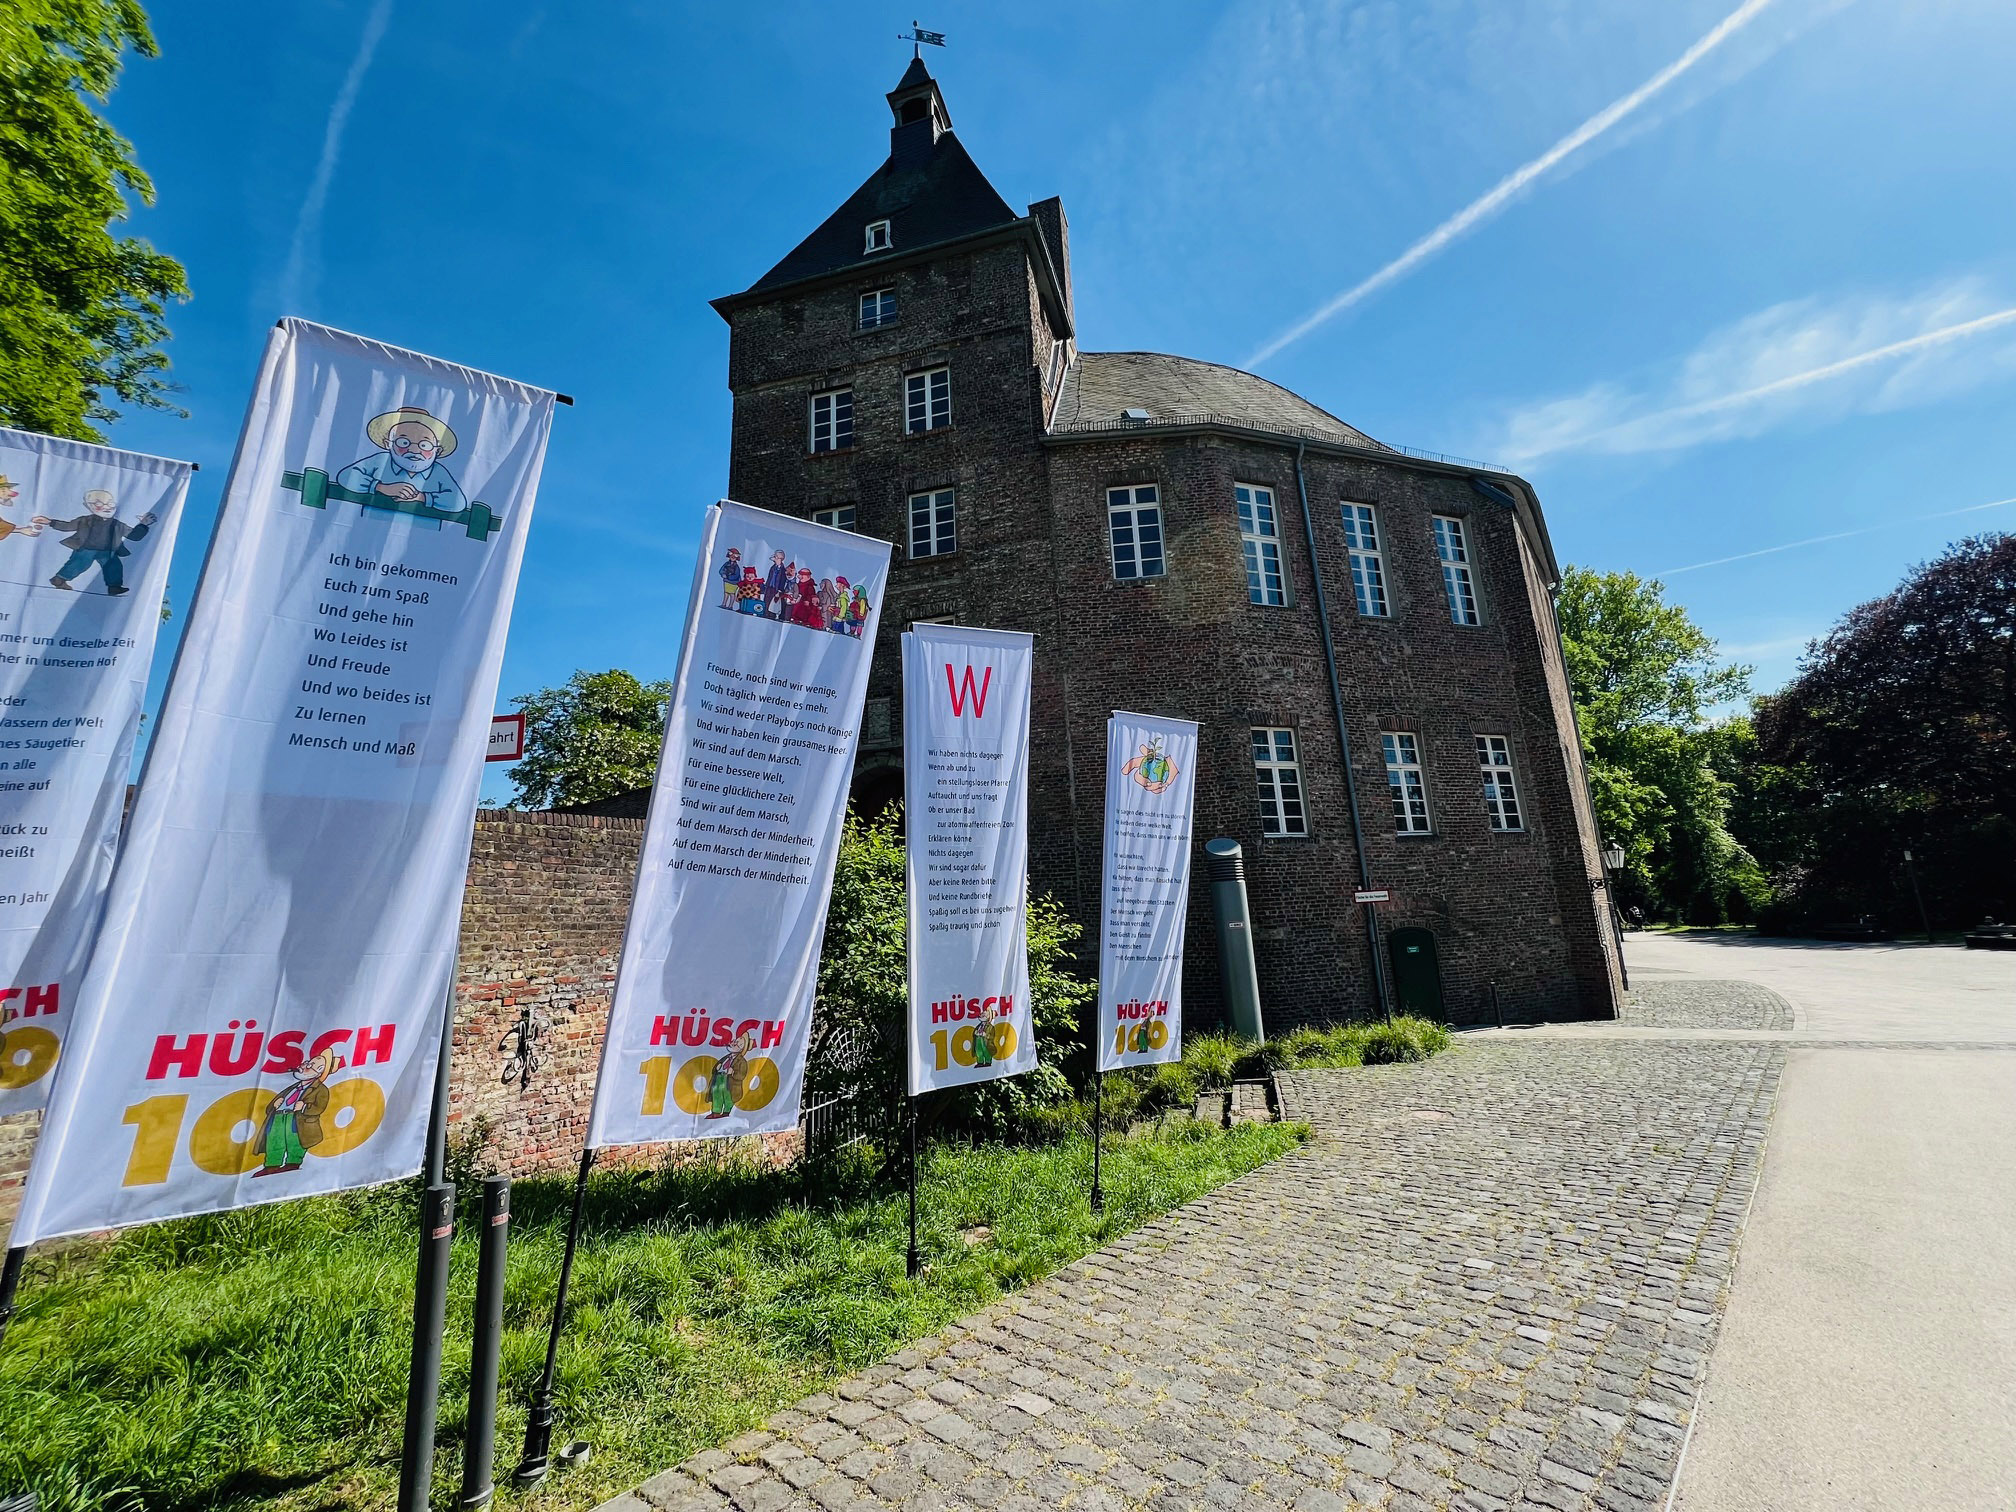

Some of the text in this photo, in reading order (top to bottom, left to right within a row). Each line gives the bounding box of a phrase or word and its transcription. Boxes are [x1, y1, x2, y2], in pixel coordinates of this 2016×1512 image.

[329, 553, 458, 585] Ich bin gekommen
[324, 578, 430, 605] Euch zum Spaß
[319, 603, 414, 627] Und gehe hin
[33, 637, 54, 646] um
[59, 637, 110, 648] dieselbe
[112, 638, 136, 648] Zeit
[314, 628, 408, 652] Wo Leides ist
[25, 655, 38, 665] in
[43, 659, 94, 668] unseren
[97, 657, 117, 666] Hof
[307, 654, 391, 675] Und Freude
[302, 680, 431, 706] Und wo beides ist
[707, 662, 838, 699] Freunde, noch sind wir wenige,
[945, 663, 992, 718] W
[704, 681, 829, 714] Doch täglich werden es mehr.
[52, 718, 72, 728] der
[75, 717, 104, 728] Welt
[295, 706, 366, 726] Zu lernen
[701, 699, 713, 711] Wir
[715, 701, 734, 716] sind
[736, 708, 765, 722] weder
[767, 714, 804, 730] Playboys
[807, 720, 826, 732] noch
[24, 738, 85, 750] Säugetier
[289, 733, 415, 755] Mensch und Maß
[696, 718, 712, 731] Und
[715, 723, 729, 734] wir
[731, 726, 760, 740] haben
[762, 732, 780, 744] kein
[783, 738, 826, 752] grausames
[13, 759, 36, 769] alle
[692, 738, 802, 766] Wir sind auf dem Marsch.
[940, 749, 958, 757] haben
[960, 750, 977, 758] nichts
[688, 757, 785, 785] Für eine bessere Welt,
[29, 780, 51, 790] auf
[684, 777, 796, 806] Für eine glücklichere Zeit,
[983, 793, 998, 802] fragt
[681, 797, 790, 824] Sind wir auf dem Marsch,
[32, 826, 48, 835] zu
[676, 817, 816, 848] Auf dem Marsch der Minderheit,
[672, 838, 813, 867] Auf dem Marsch der Minderheit,
[948, 850, 973, 858] dagegen
[668, 858, 810, 885] Auf dem Marsch der Minderheit.
[953, 865, 969, 873] sogar
[20, 891, 49, 905] Jahr
[950, 907, 960, 915] soll
[970, 906, 979, 914] bei
[950, 922, 969, 930] traurig
[931, 994, 1013, 1024] HÜSCH
[1117, 999, 1168, 1020] HÜSCH
[649, 1008, 785, 1049] HÜSCH
[1115, 1020, 1169, 1056] 100
[145, 1019, 396, 1080] HÜSCH
[930, 1021, 1017, 1071] 100
[639, 1055, 779, 1115] 100
[121, 1077, 385, 1187] 100
